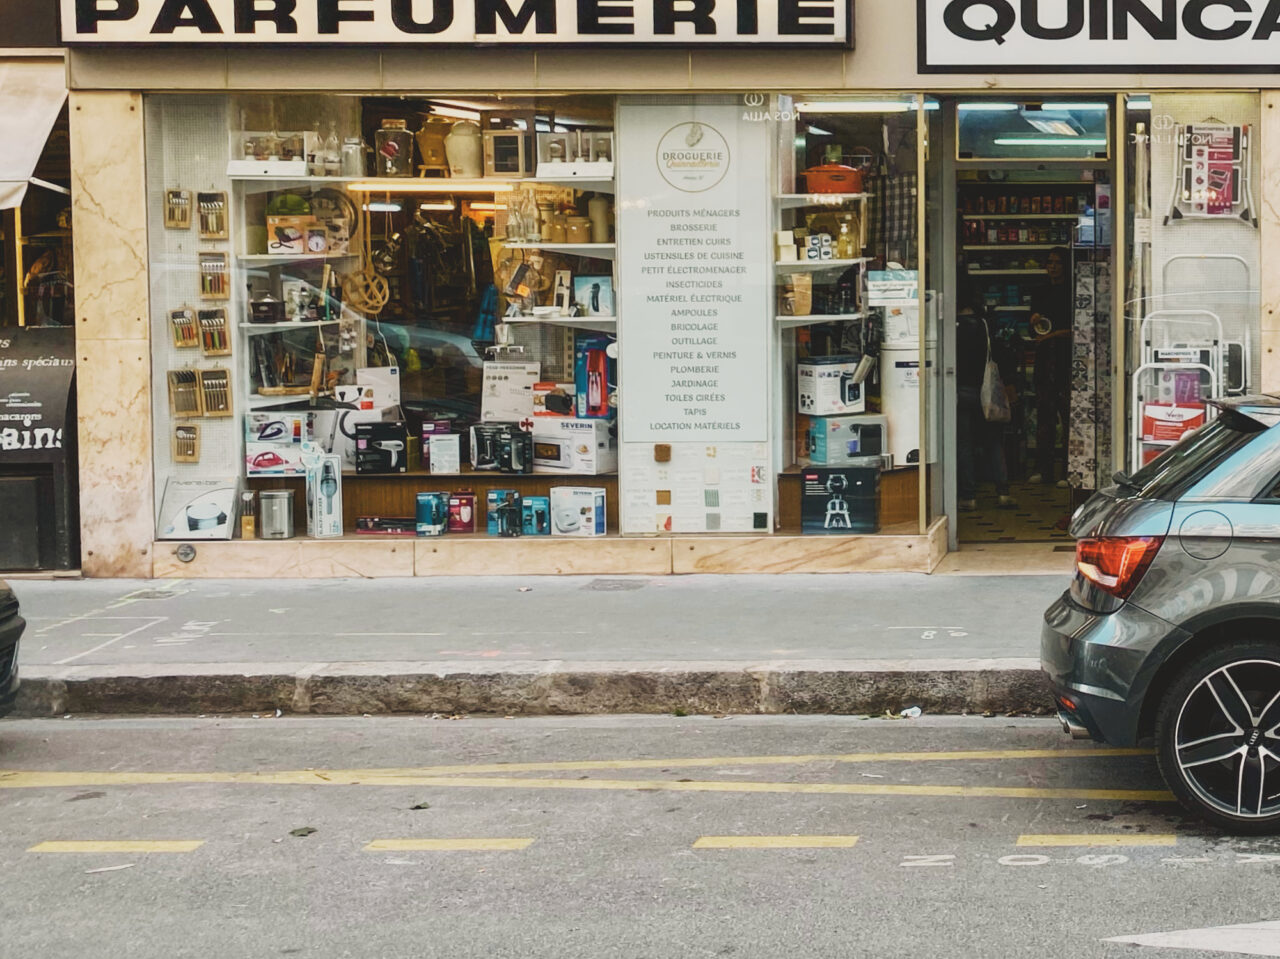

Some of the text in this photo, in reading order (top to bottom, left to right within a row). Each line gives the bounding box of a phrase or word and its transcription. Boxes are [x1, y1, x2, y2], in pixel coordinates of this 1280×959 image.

[662, 152, 723, 161] DROGUERIE
[647, 208, 741, 218] PRODUITS MÉNAGERS
[670, 223, 718, 232] BROSSERIE
[656, 238, 731, 246] ENTRETIEN CUIRS
[644, 252, 745, 260] USTENSILES DE CUISINE
[641, 266, 665, 274] PETIT
[665, 280, 723, 288] INSECTICIDES
[646, 293, 743, 304] MATÉRIEL ÉLECTRIQUE
[671, 309, 718, 317] AMPOULES
[670, 323, 718, 331] BRICOLAGE
[671, 337, 718, 345] OUTILLAGE
[653, 351, 737, 359] PEINTURE & VERNIS
[670, 365, 720, 374] PLOMBERIE
[671, 379, 719, 388] JARDINAGE
[665, 392, 726, 402] TOILES CIRÉES
[684, 408, 707, 416] TAPIS
[560, 421, 593, 430] SEVERIN
[649, 421, 741, 431] LOCATION MATÉRIELS
